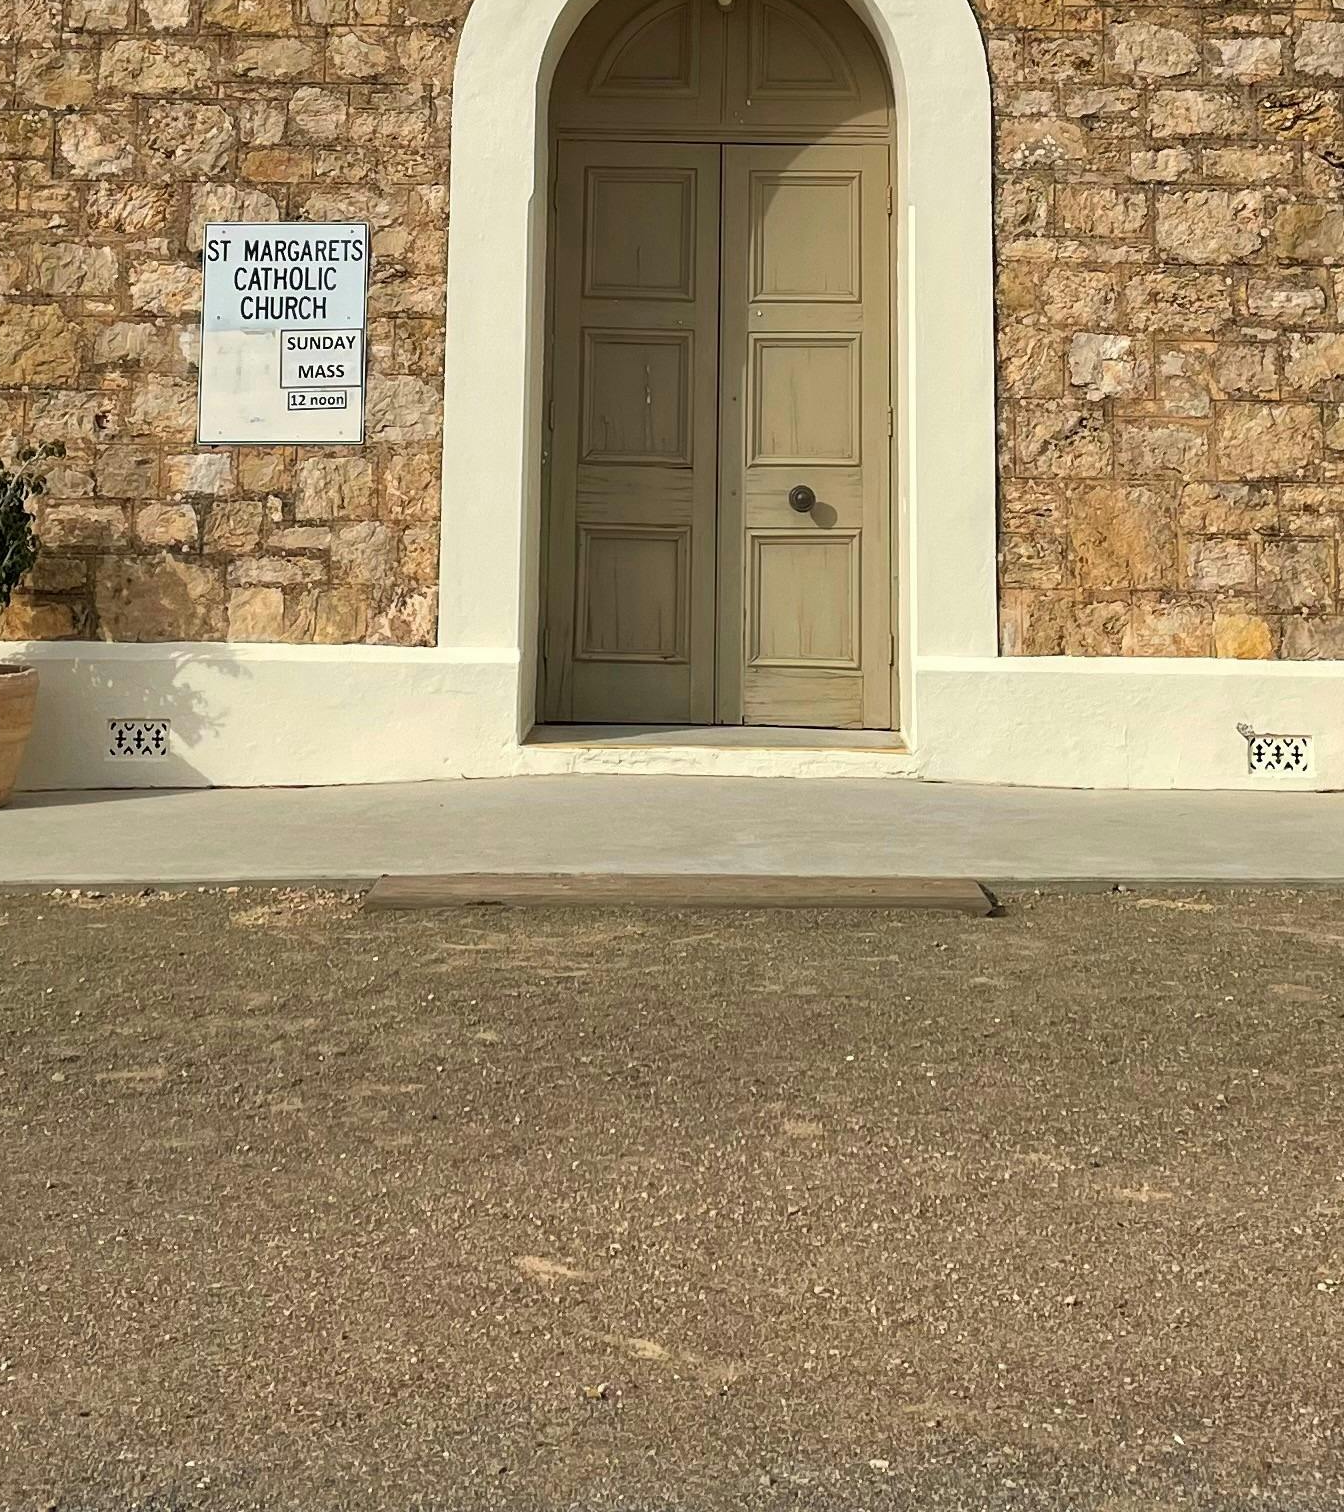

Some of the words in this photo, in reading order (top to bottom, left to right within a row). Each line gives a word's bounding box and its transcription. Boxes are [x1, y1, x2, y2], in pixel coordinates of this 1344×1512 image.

[207, 239, 231, 262] ST
[244, 239, 363, 262] MARGARETS
[234, 267, 337, 291] CATHOLIC
[240, 296, 327, 320] CHURCH
[287, 336, 356, 350] SUNDAY
[298, 365, 345, 378] MASS
[291, 395, 305, 406] 12
[310, 395, 344, 405] noon
